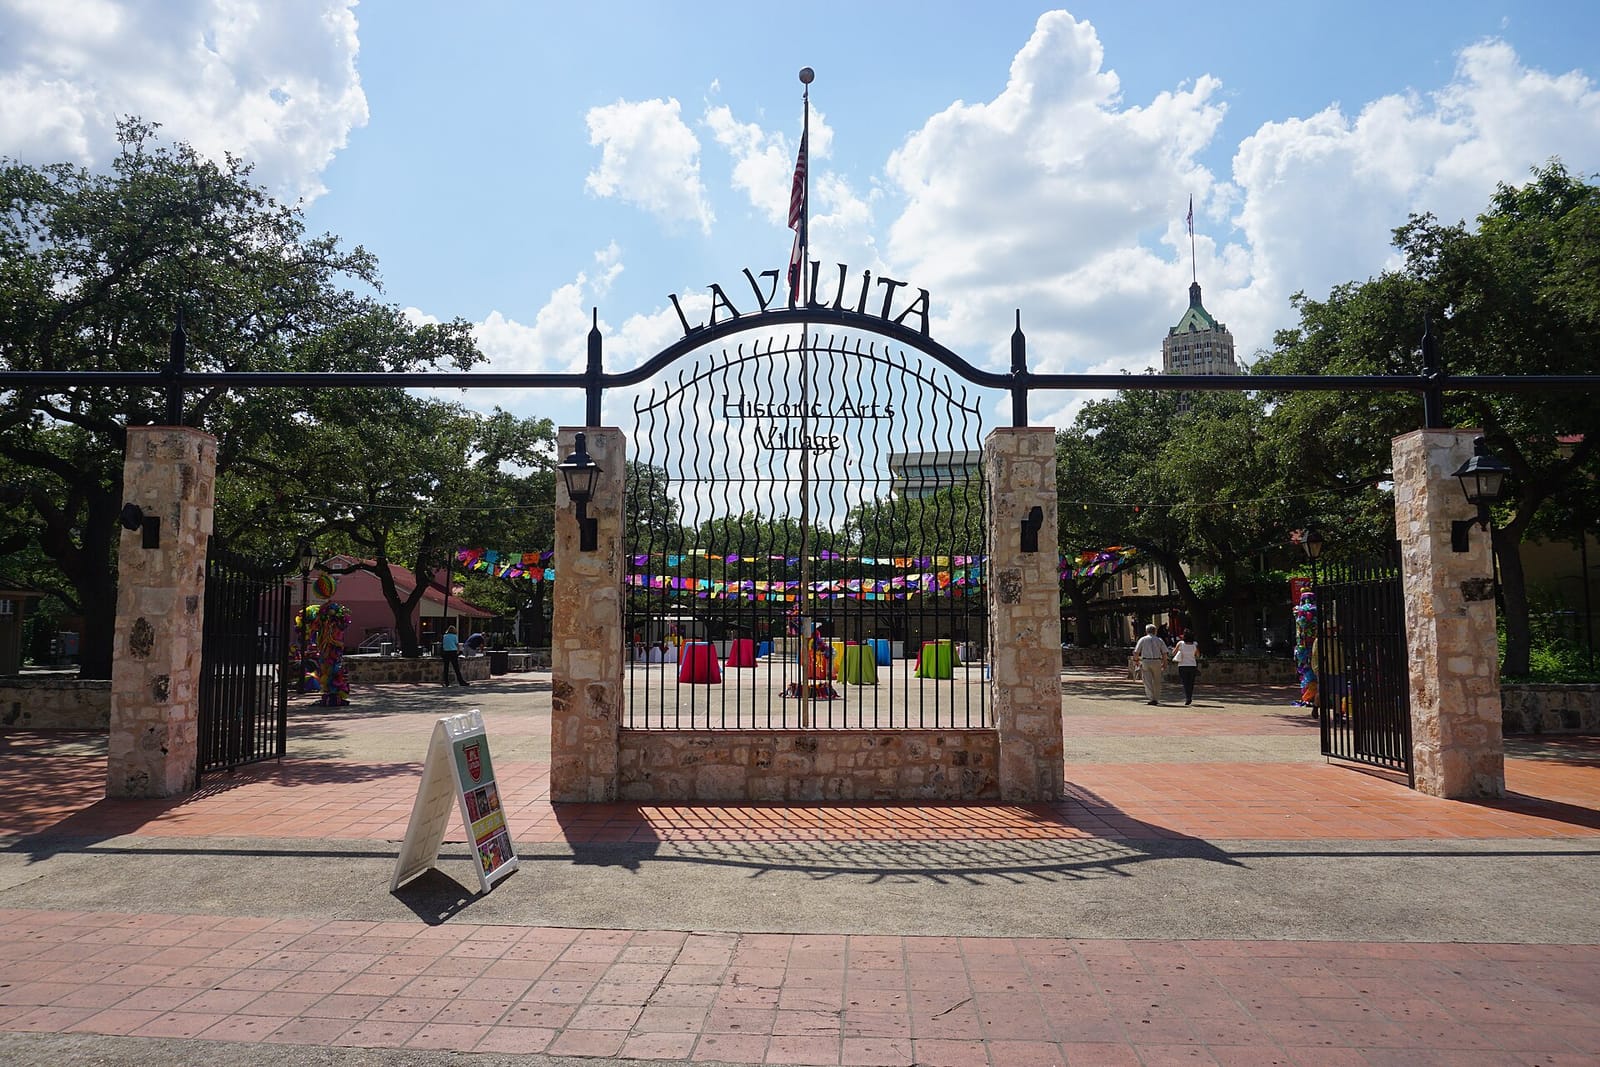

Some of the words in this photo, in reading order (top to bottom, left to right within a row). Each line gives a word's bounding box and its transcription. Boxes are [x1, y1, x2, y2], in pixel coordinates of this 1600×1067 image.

[668, 284, 741, 337] LA
[722, 394, 823, 418] Historic
[834, 394, 896, 418] Arts
[757, 426, 841, 456] Village
